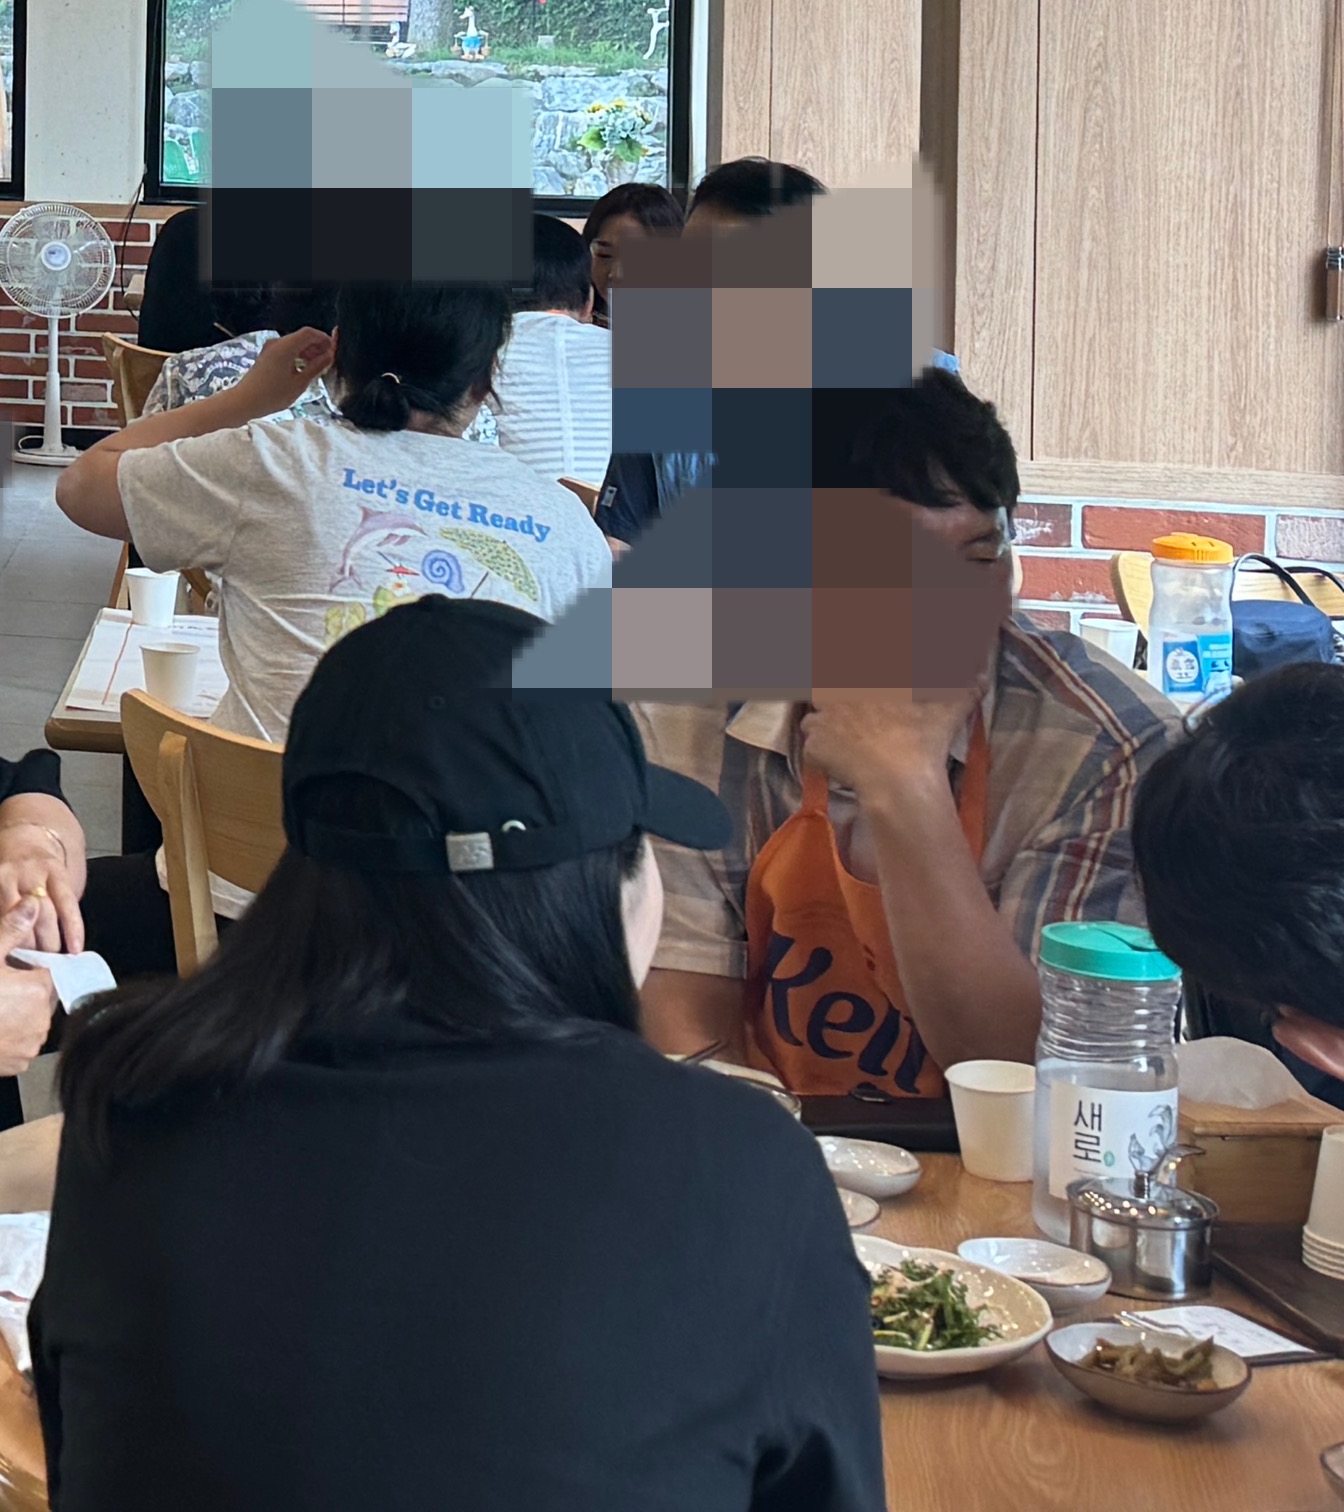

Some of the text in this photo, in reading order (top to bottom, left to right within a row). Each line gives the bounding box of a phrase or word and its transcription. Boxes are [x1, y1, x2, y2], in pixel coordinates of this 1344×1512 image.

[342, 467, 551, 543] Let's Get Ready
[766, 931, 928, 1094] Kell
[1072, 1099, 1103, 1163] 새로
